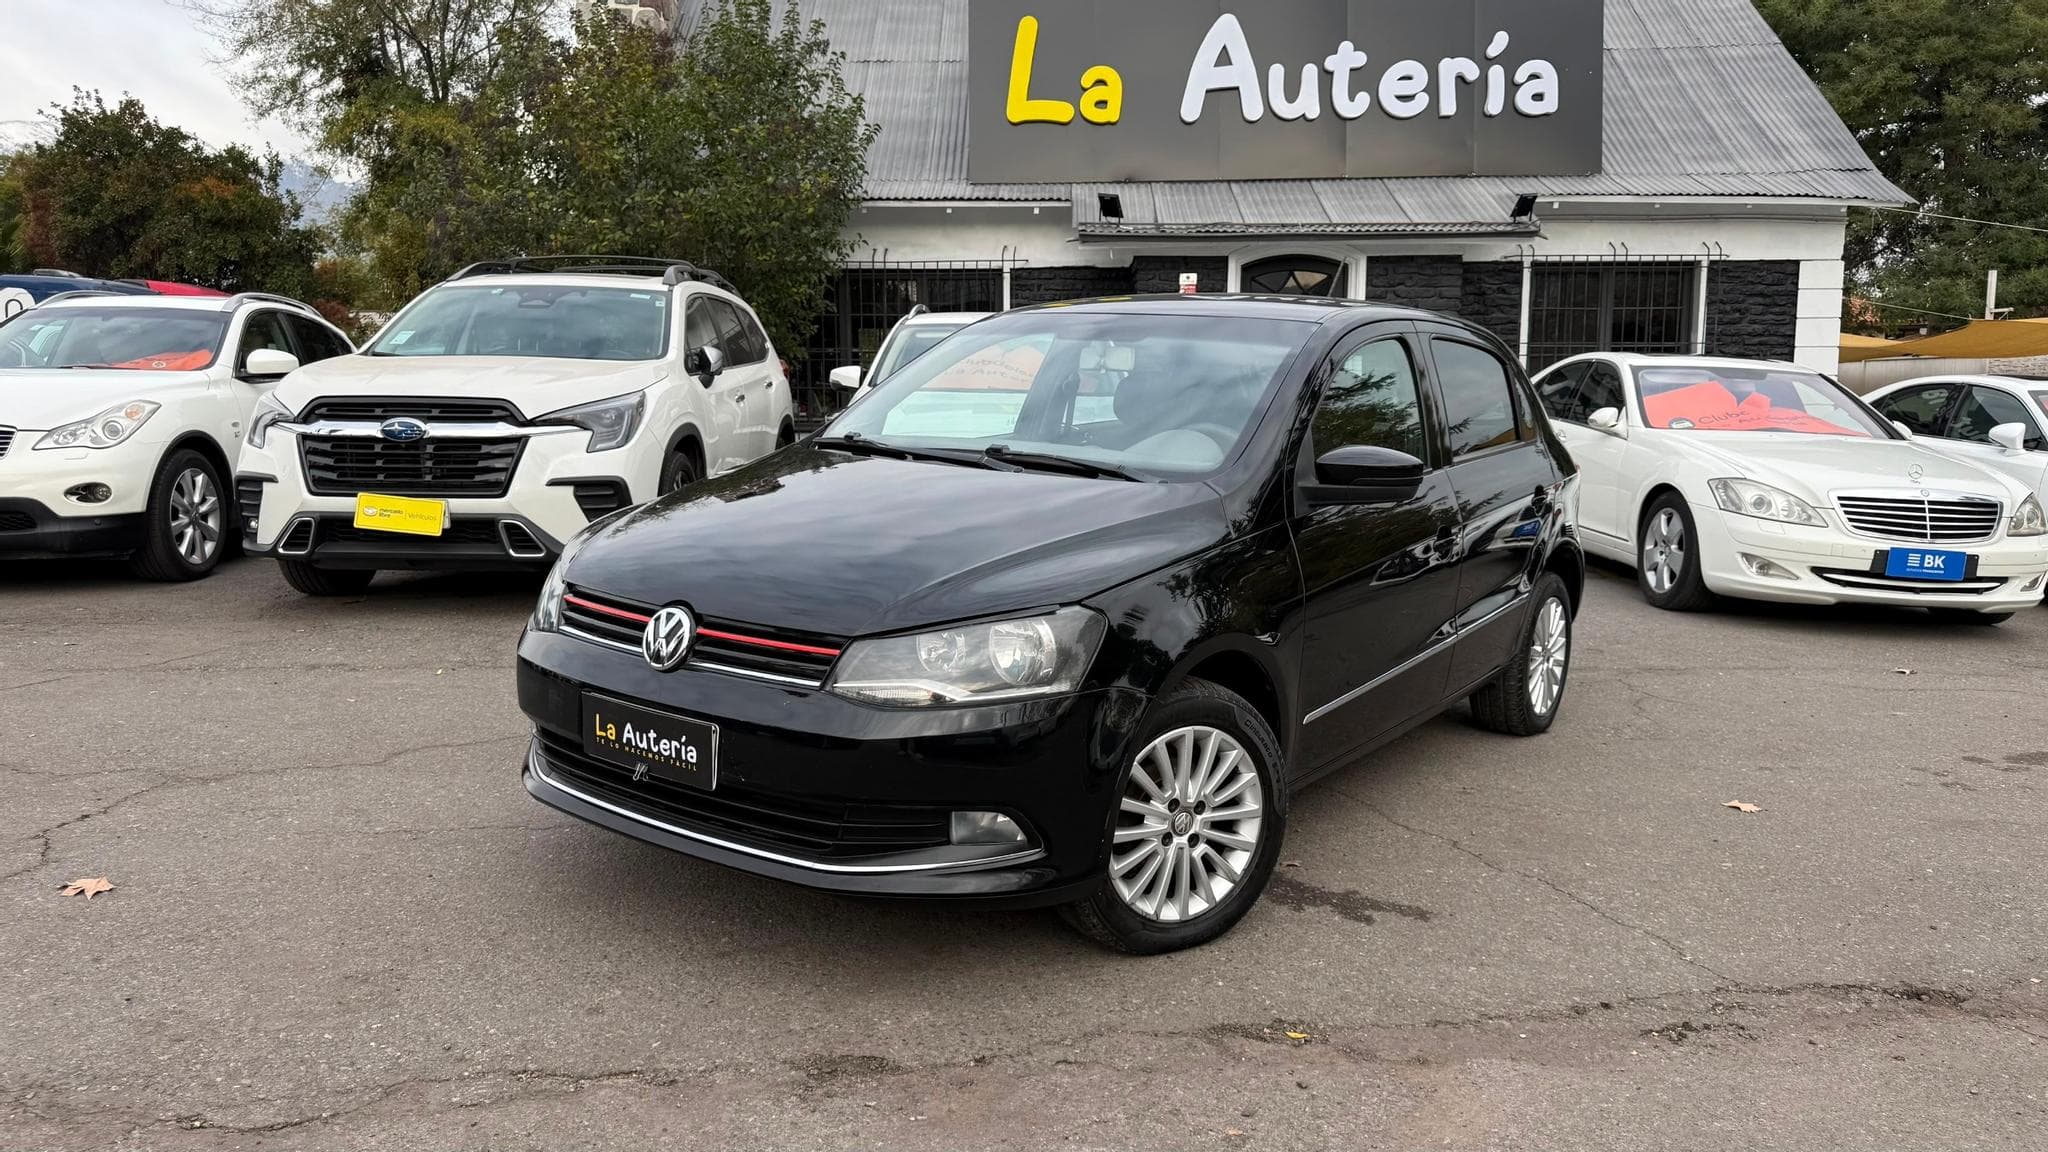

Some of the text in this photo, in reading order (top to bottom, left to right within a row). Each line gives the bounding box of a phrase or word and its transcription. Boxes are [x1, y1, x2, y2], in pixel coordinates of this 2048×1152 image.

[1006, 12, 1560, 125] La Autería
[1923, 554, 1946, 569] BK
[595, 713, 698, 763] La Autería
[596, 736, 606, 745] TE
[624, 745, 665, 763] HACENOS
